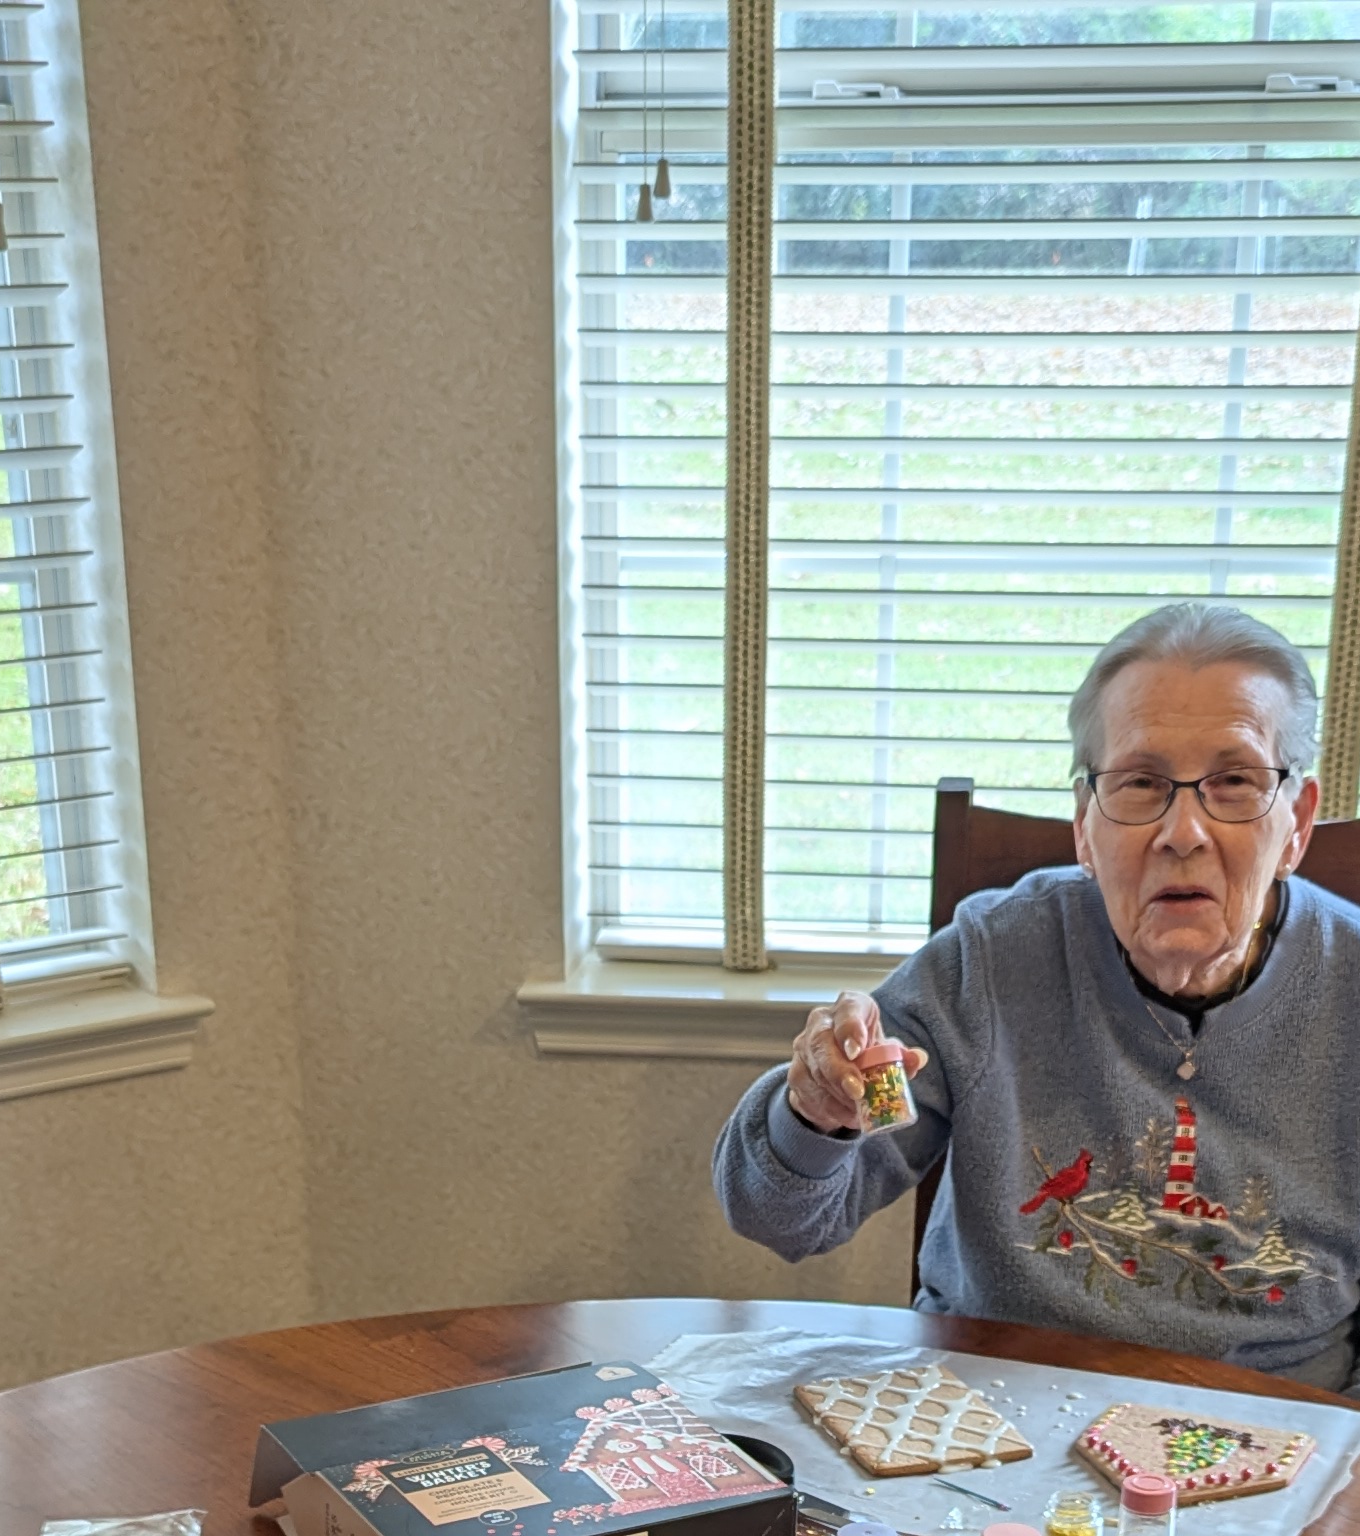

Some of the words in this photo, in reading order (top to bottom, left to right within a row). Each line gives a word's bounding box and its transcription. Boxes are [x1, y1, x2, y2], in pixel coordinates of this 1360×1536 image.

[397, 1464, 439, 1476] LIMITED
[442, 1455, 483, 1467] EDITION
[405, 1461, 491, 1482] WINTER'S
[421, 1468, 488, 1487] BASKET
[429, 1480, 494, 1496] CHOCOLATE
[435, 1483, 502, 1499] PEPPERMINT
[450, 1496, 487, 1506] HOUSE
